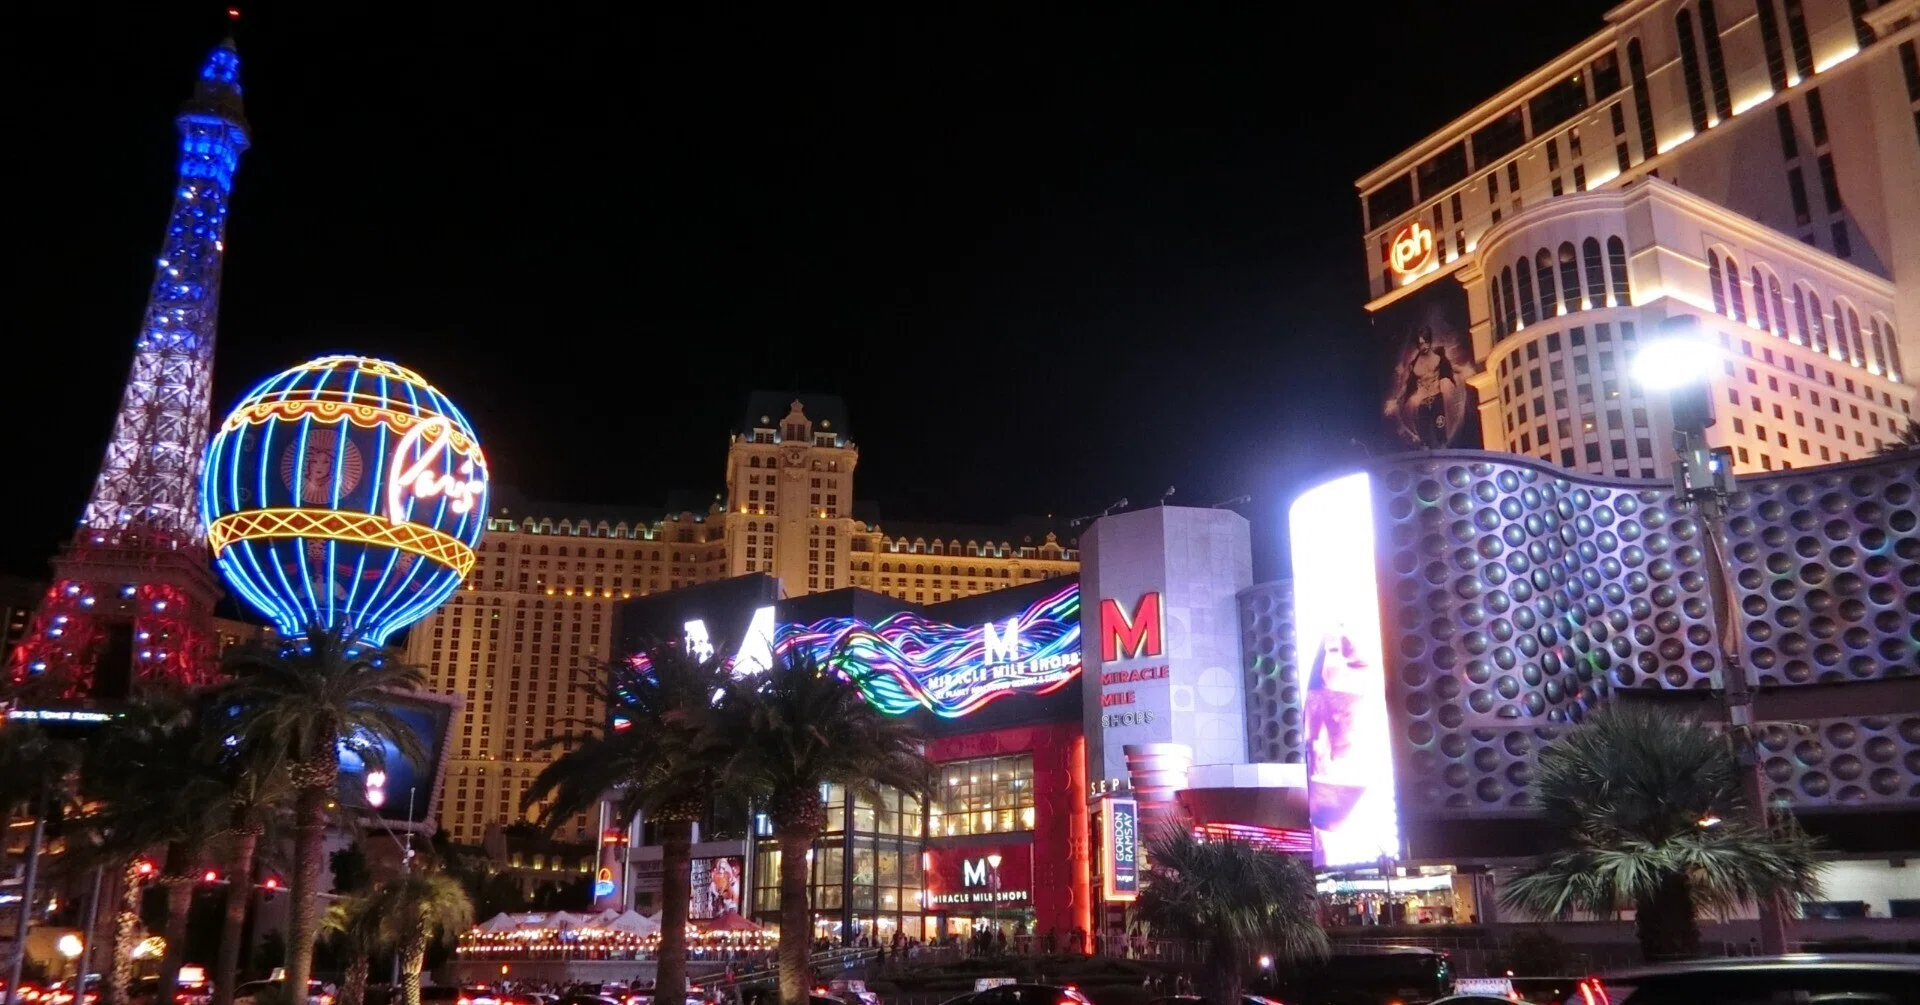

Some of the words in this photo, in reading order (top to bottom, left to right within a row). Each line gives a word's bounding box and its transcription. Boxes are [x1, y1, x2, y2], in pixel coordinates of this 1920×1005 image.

[1396, 222, 1432, 269] ph
[388, 416, 486, 525] Paris
[1101, 591, 1163, 662] M
[984, 617, 1019, 666] M
[928, 669, 987, 690] MIRACLE
[993, 661, 1026, 680] MILE
[1099, 665, 1170, 686] MIRACLE
[1099, 690, 1136, 707] MILE
[1101, 710, 1154, 728] SHOPS
[1115, 811, 1124, 861] GORDON
[1125, 812, 1134, 862] RAMSAY
[964, 858, 986, 887] M
[1116, 874, 1134, 883] burger
[931, 893, 969, 903] MIRACLE
[973, 892, 993, 902] MILE
[996, 891, 1028, 901] SHOPS
